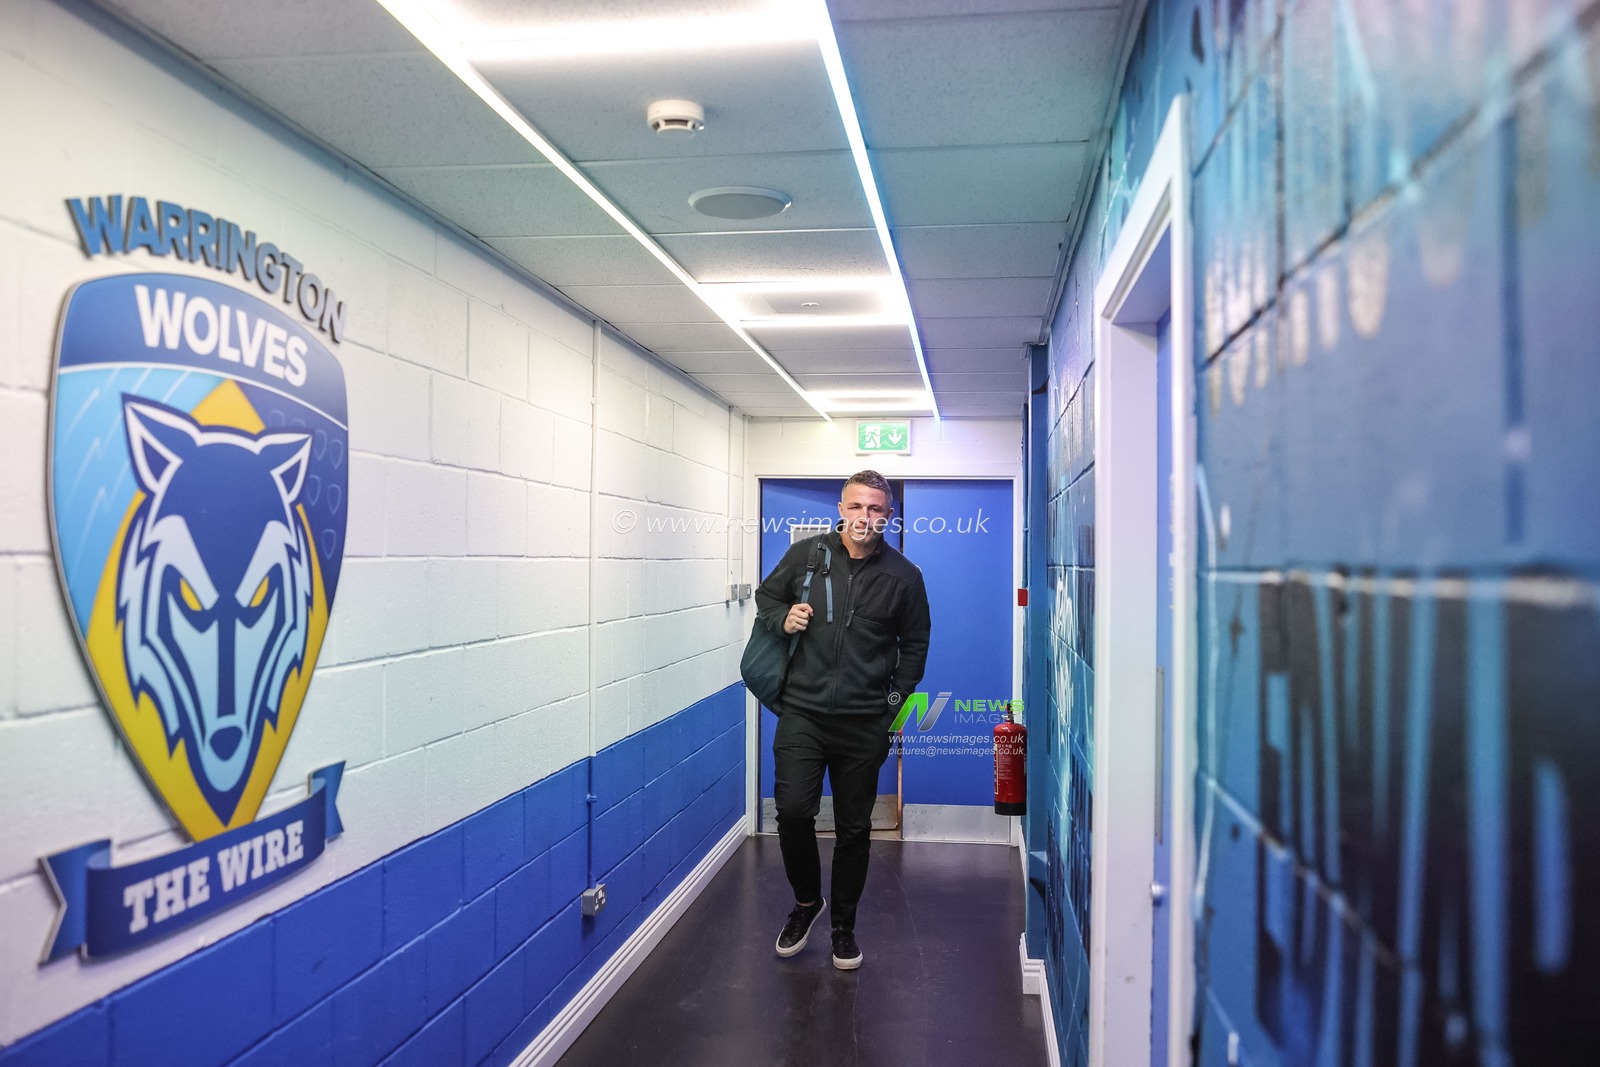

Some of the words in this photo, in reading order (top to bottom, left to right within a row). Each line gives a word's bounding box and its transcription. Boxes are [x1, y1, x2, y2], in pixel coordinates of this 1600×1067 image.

[65, 193, 347, 343] WARRINGTON
[134, 284, 308, 387] WOLVES
[123, 857, 210, 934] THE
[217, 820, 304, 892] WIRE
